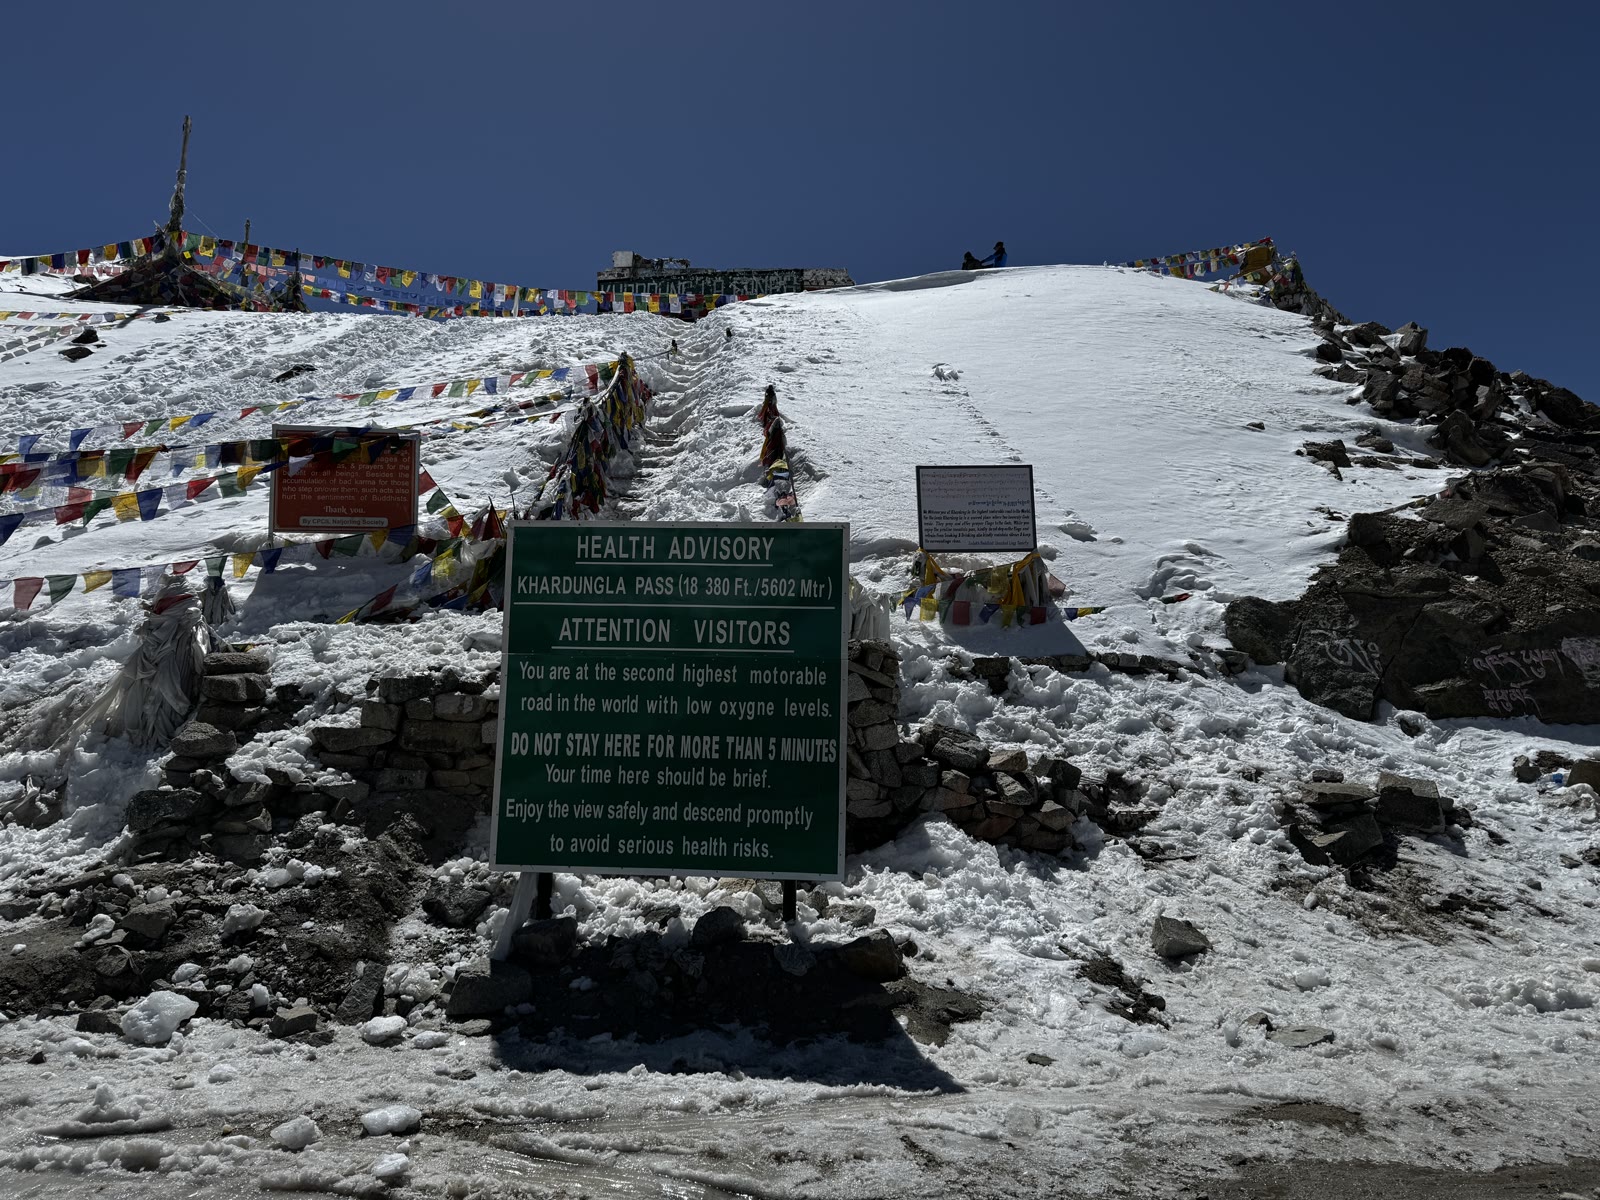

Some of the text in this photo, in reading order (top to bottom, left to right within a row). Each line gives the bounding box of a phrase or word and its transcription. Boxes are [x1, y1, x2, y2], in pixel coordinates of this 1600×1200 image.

[366, 470, 394, 478] Besides
[298, 486, 312, 494] step
[323, 505, 366, 515] Thank you.
[578, 536, 774, 560] HEALTH ADVISORY
[518, 576, 626, 594] KHARDUNGLA
[636, 577, 673, 595] PASS
[706, 577, 729, 595] 380
[559, 618, 789, 645] ATTENTION VISITORS
[520, 662, 826, 687] You are at the second highest motorable
[522, 693, 831, 720] road in the world with low oxygne levels.
[511, 733, 836, 762] DO NOT STAY HERE FOR MORE THAN 5 MINUTES
[546, 764, 770, 787] Your time here should be brief.
[506, 799, 813, 830] Enjoy the view safely and descend promptly
[551, 834, 773, 857] to avoid serious health risks.
